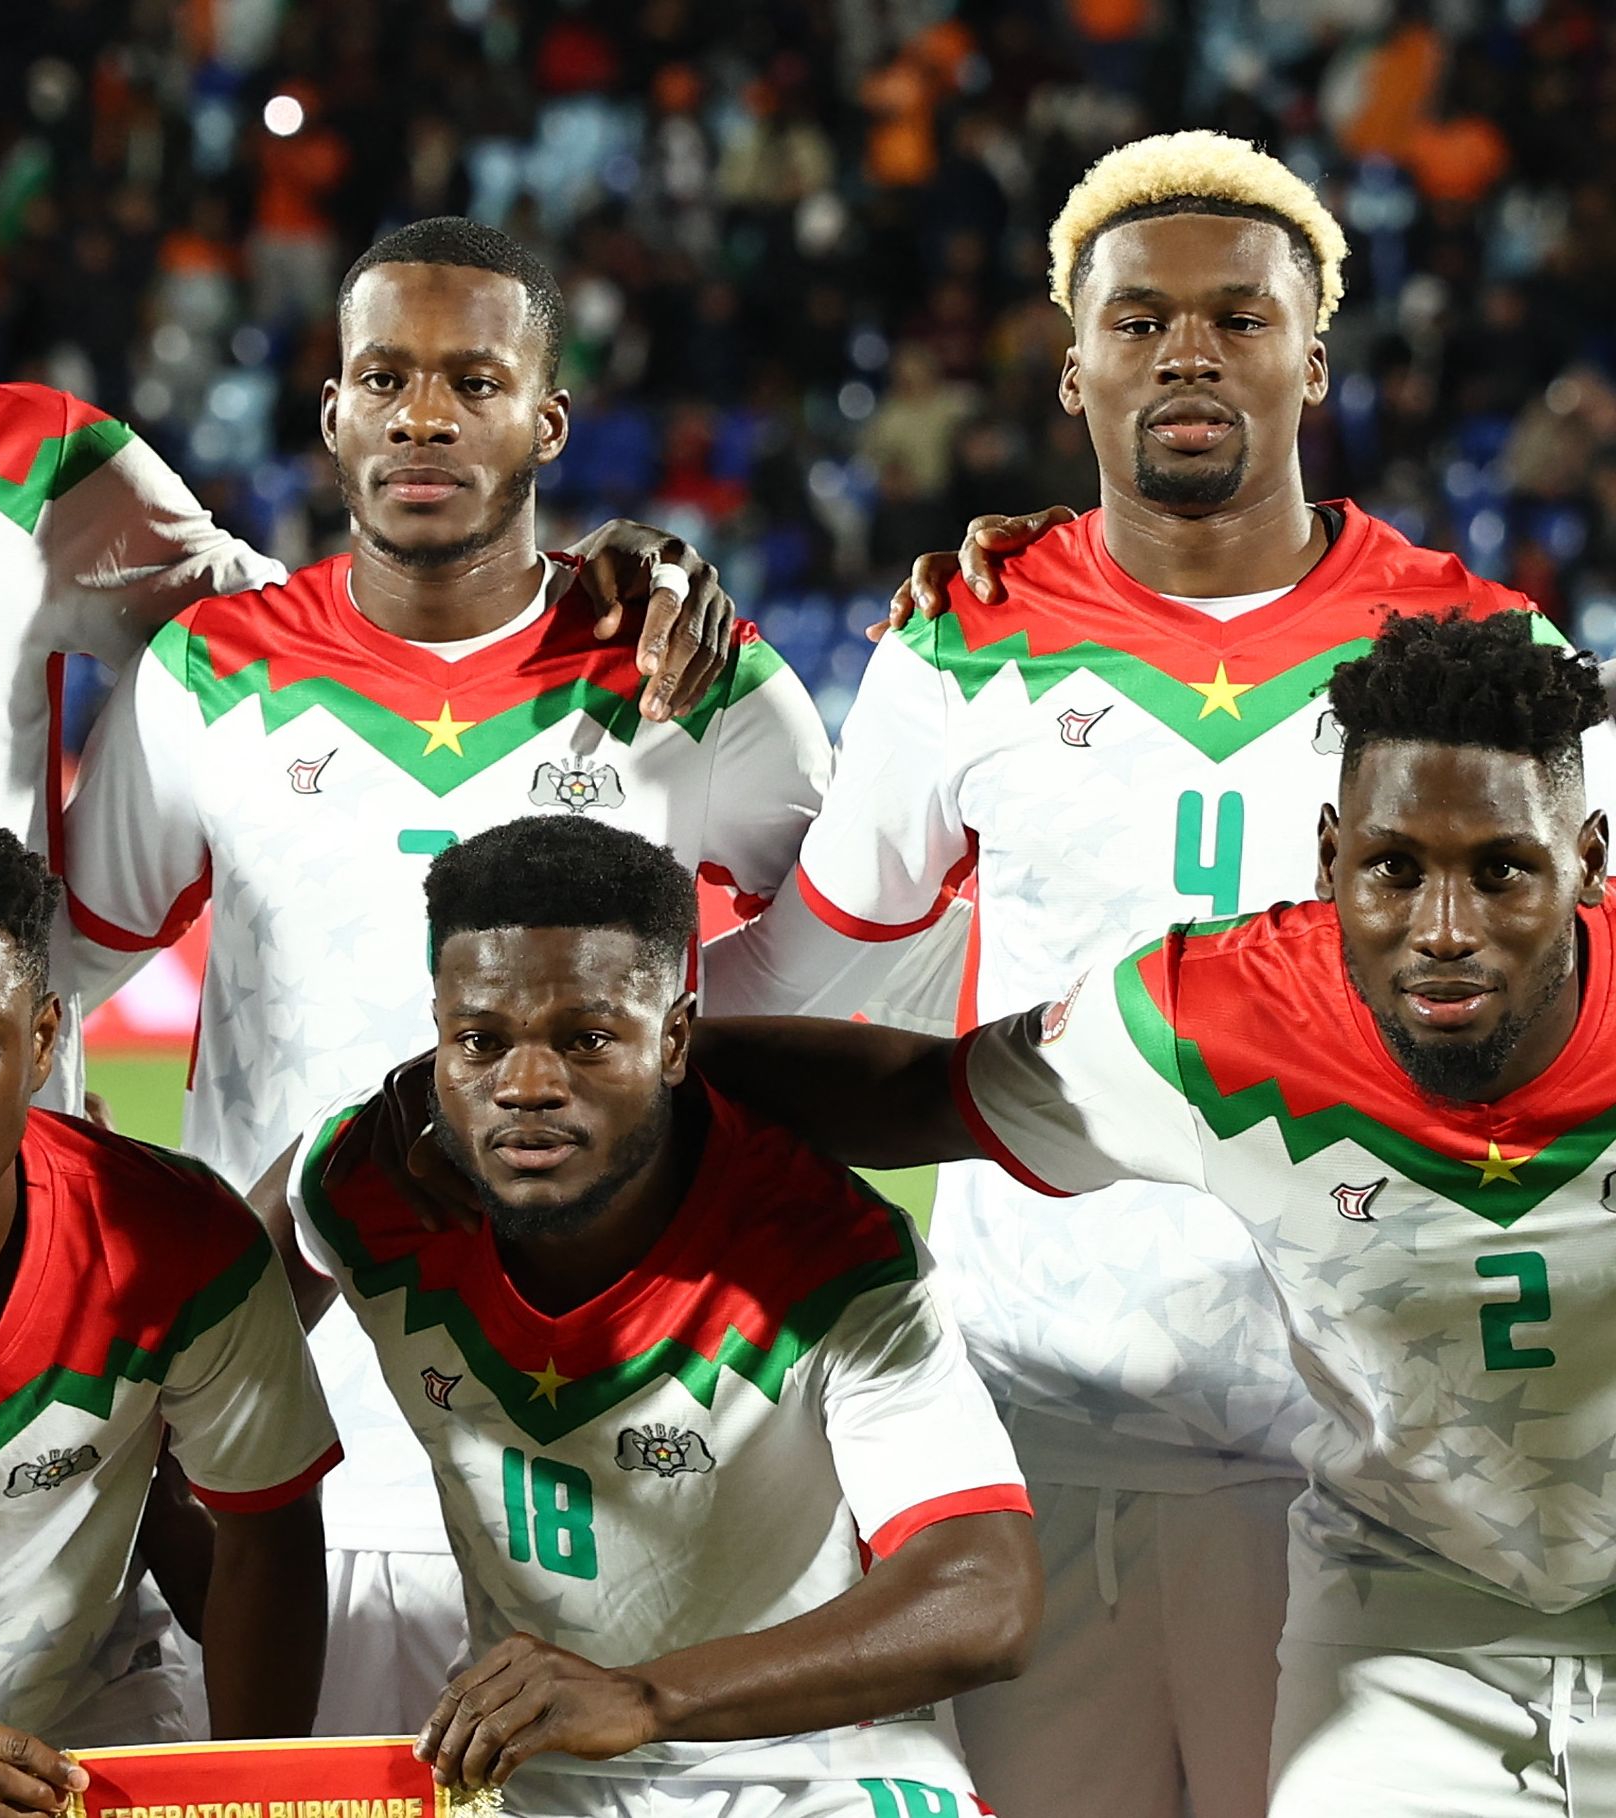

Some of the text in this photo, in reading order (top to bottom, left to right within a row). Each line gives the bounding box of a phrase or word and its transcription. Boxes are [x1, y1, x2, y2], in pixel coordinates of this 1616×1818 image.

[1174, 790, 1244, 915] 4
[1475, 1251, 1555, 1371] 2
[502, 1447, 598, 1581] 18
[268, 1798, 423, 1818] BURKINABE
